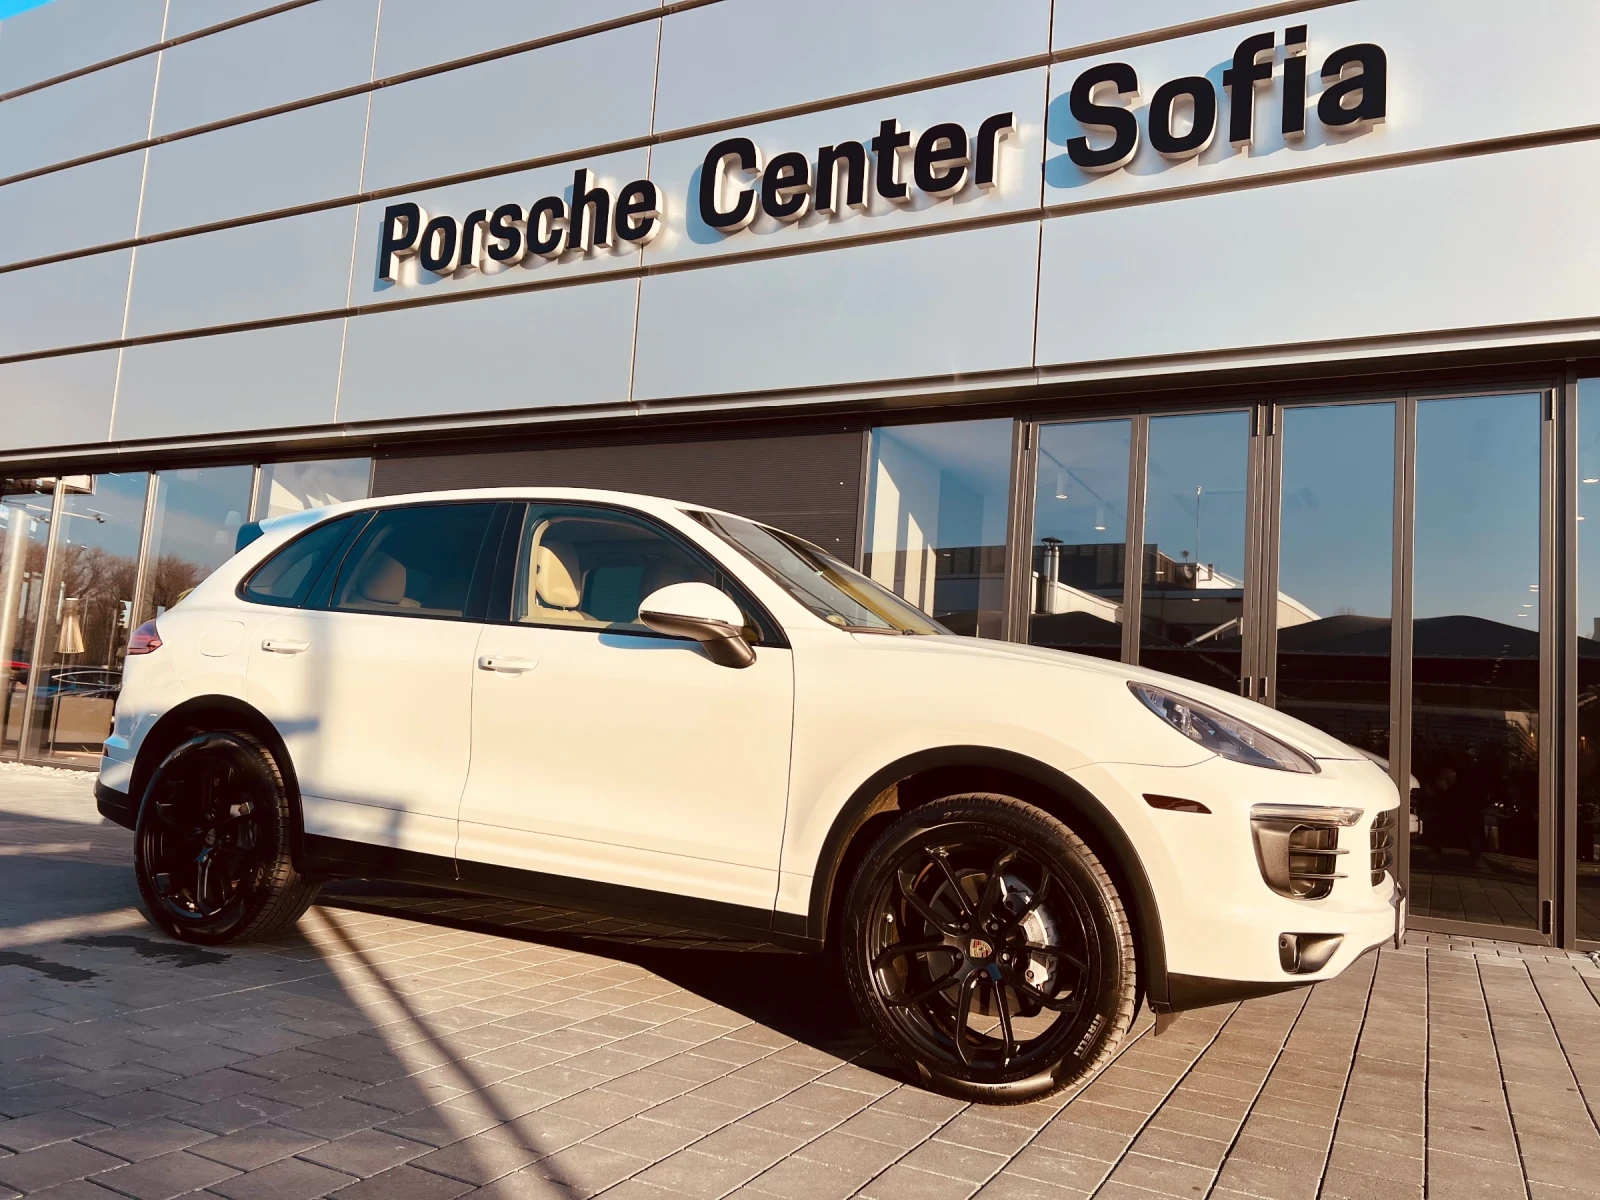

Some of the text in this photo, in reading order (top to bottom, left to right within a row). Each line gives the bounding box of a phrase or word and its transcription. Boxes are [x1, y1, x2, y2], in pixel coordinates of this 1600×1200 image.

[379, 24, 1387, 281] Porsche Center Sofia
